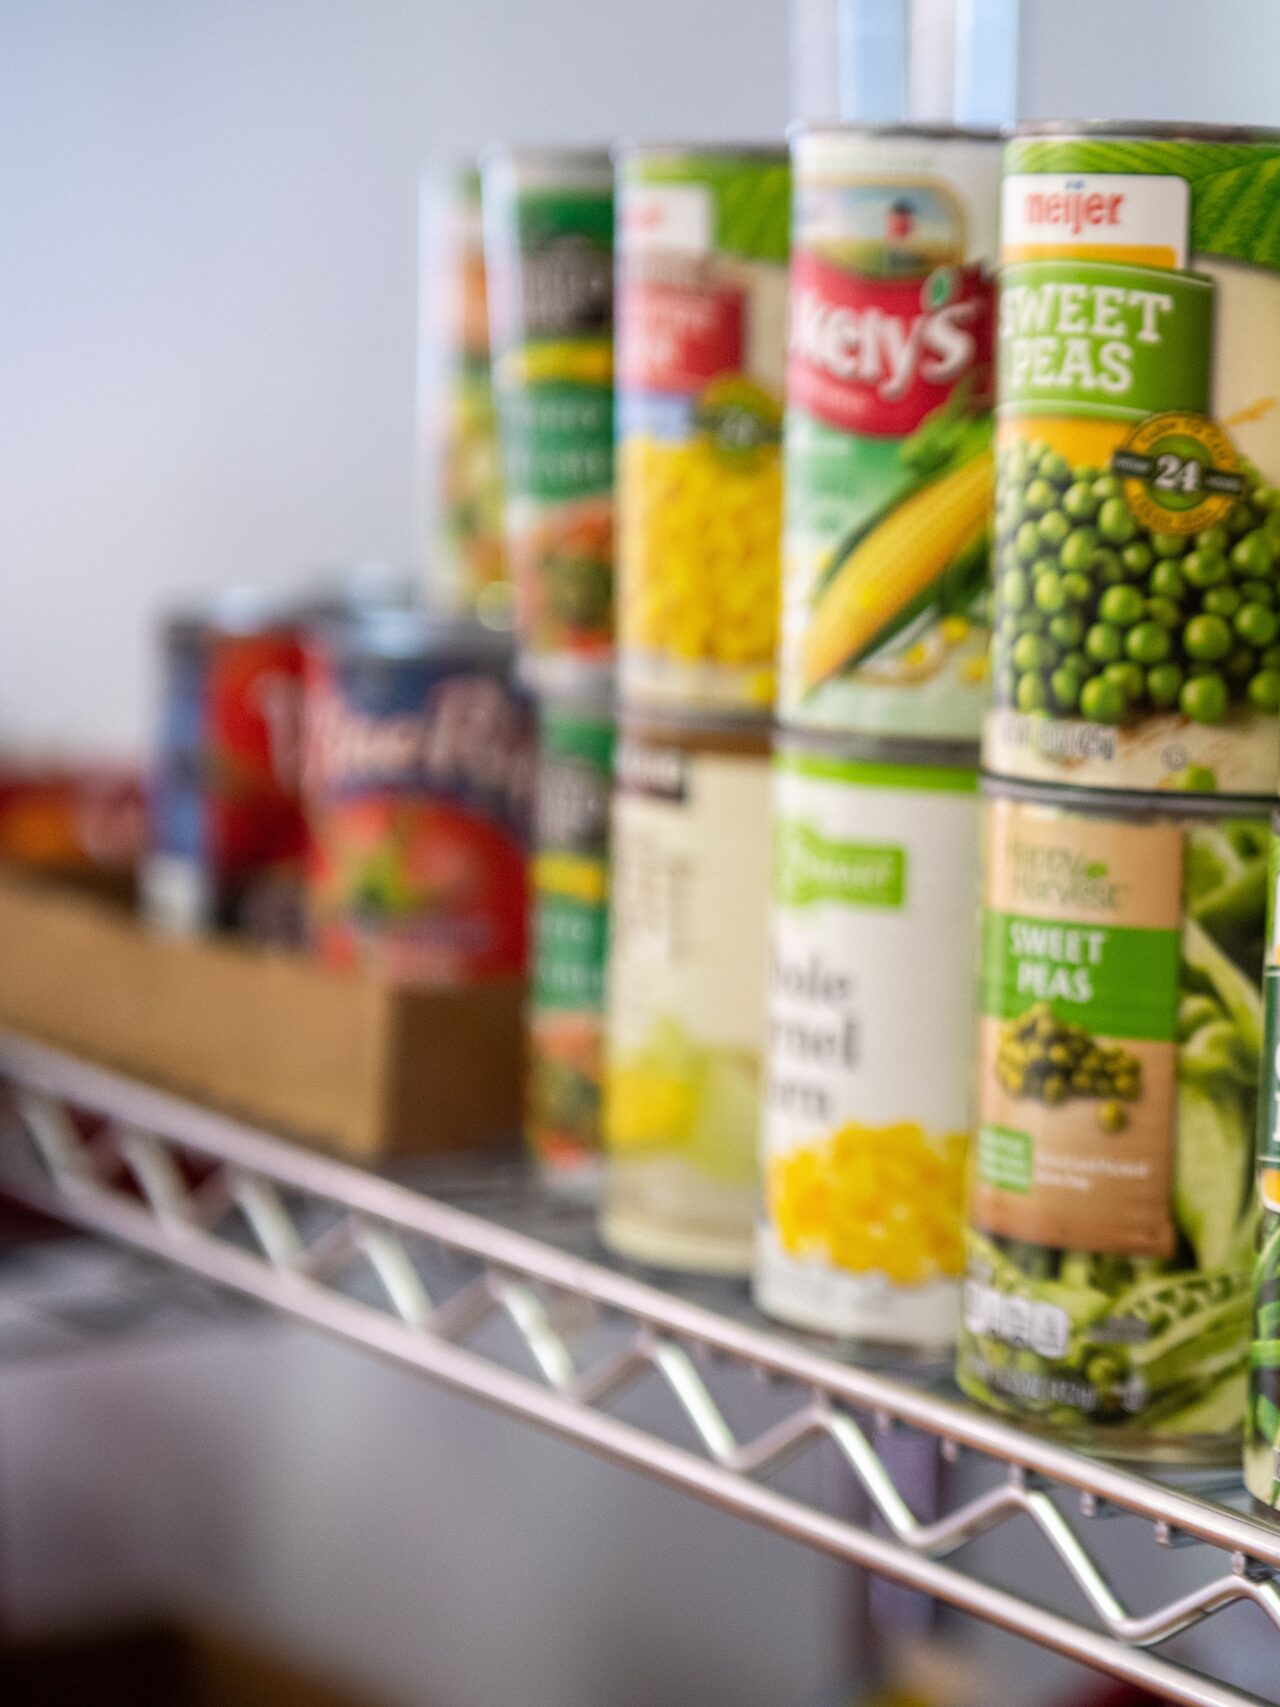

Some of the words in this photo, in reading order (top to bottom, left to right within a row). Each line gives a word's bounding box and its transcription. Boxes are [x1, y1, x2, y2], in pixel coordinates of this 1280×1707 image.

[1024, 178, 1125, 236] meijer
[1009, 335, 1134, 394] PEAS
[1154, 453, 1200, 493] 24
[1010, 921, 1106, 966] SWEET
[1016, 961, 1093, 1004] PEAS
